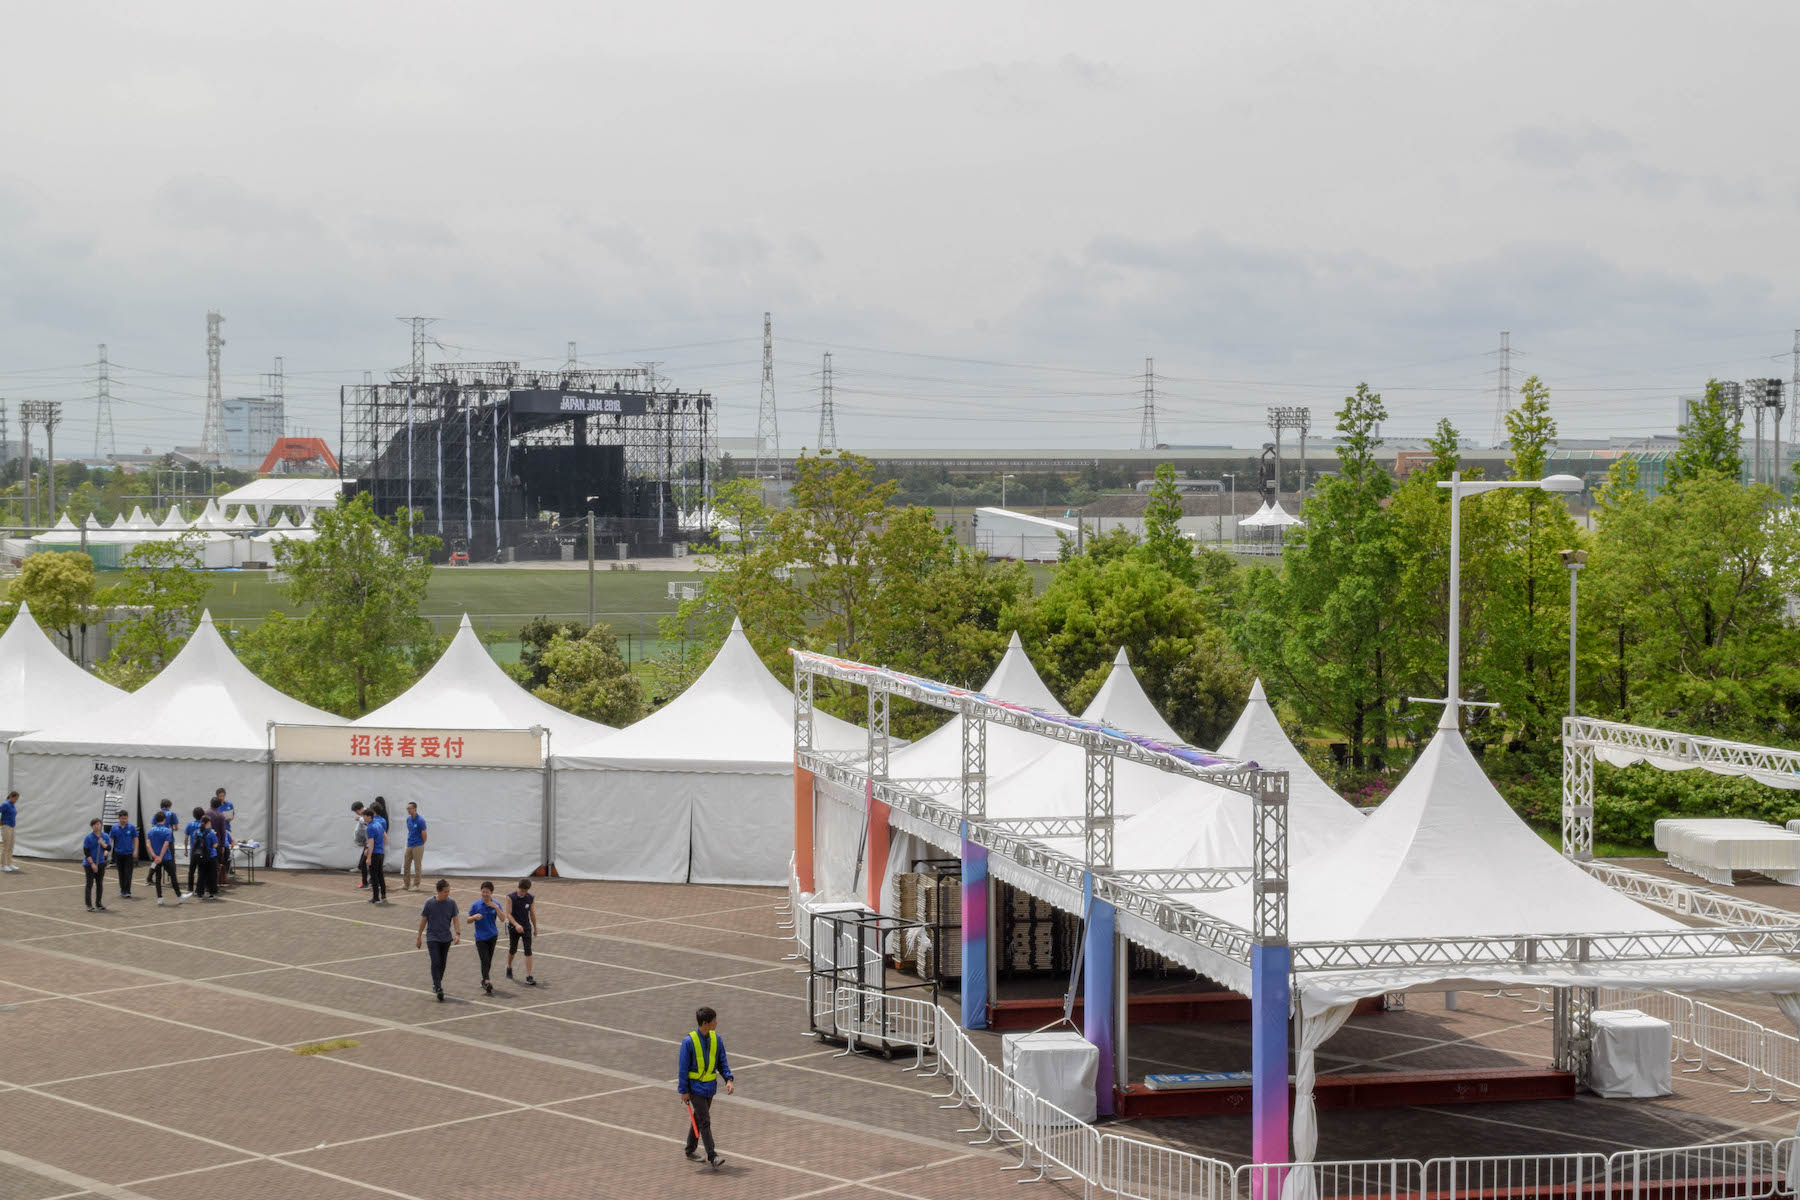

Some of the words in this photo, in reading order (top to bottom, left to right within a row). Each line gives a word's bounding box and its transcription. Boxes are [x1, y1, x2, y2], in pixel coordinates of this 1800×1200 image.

[560, 398, 586, 410] JAPAN
[587, 399, 603, 411] JAM
[350, 734, 465, 758] 招待者受付
